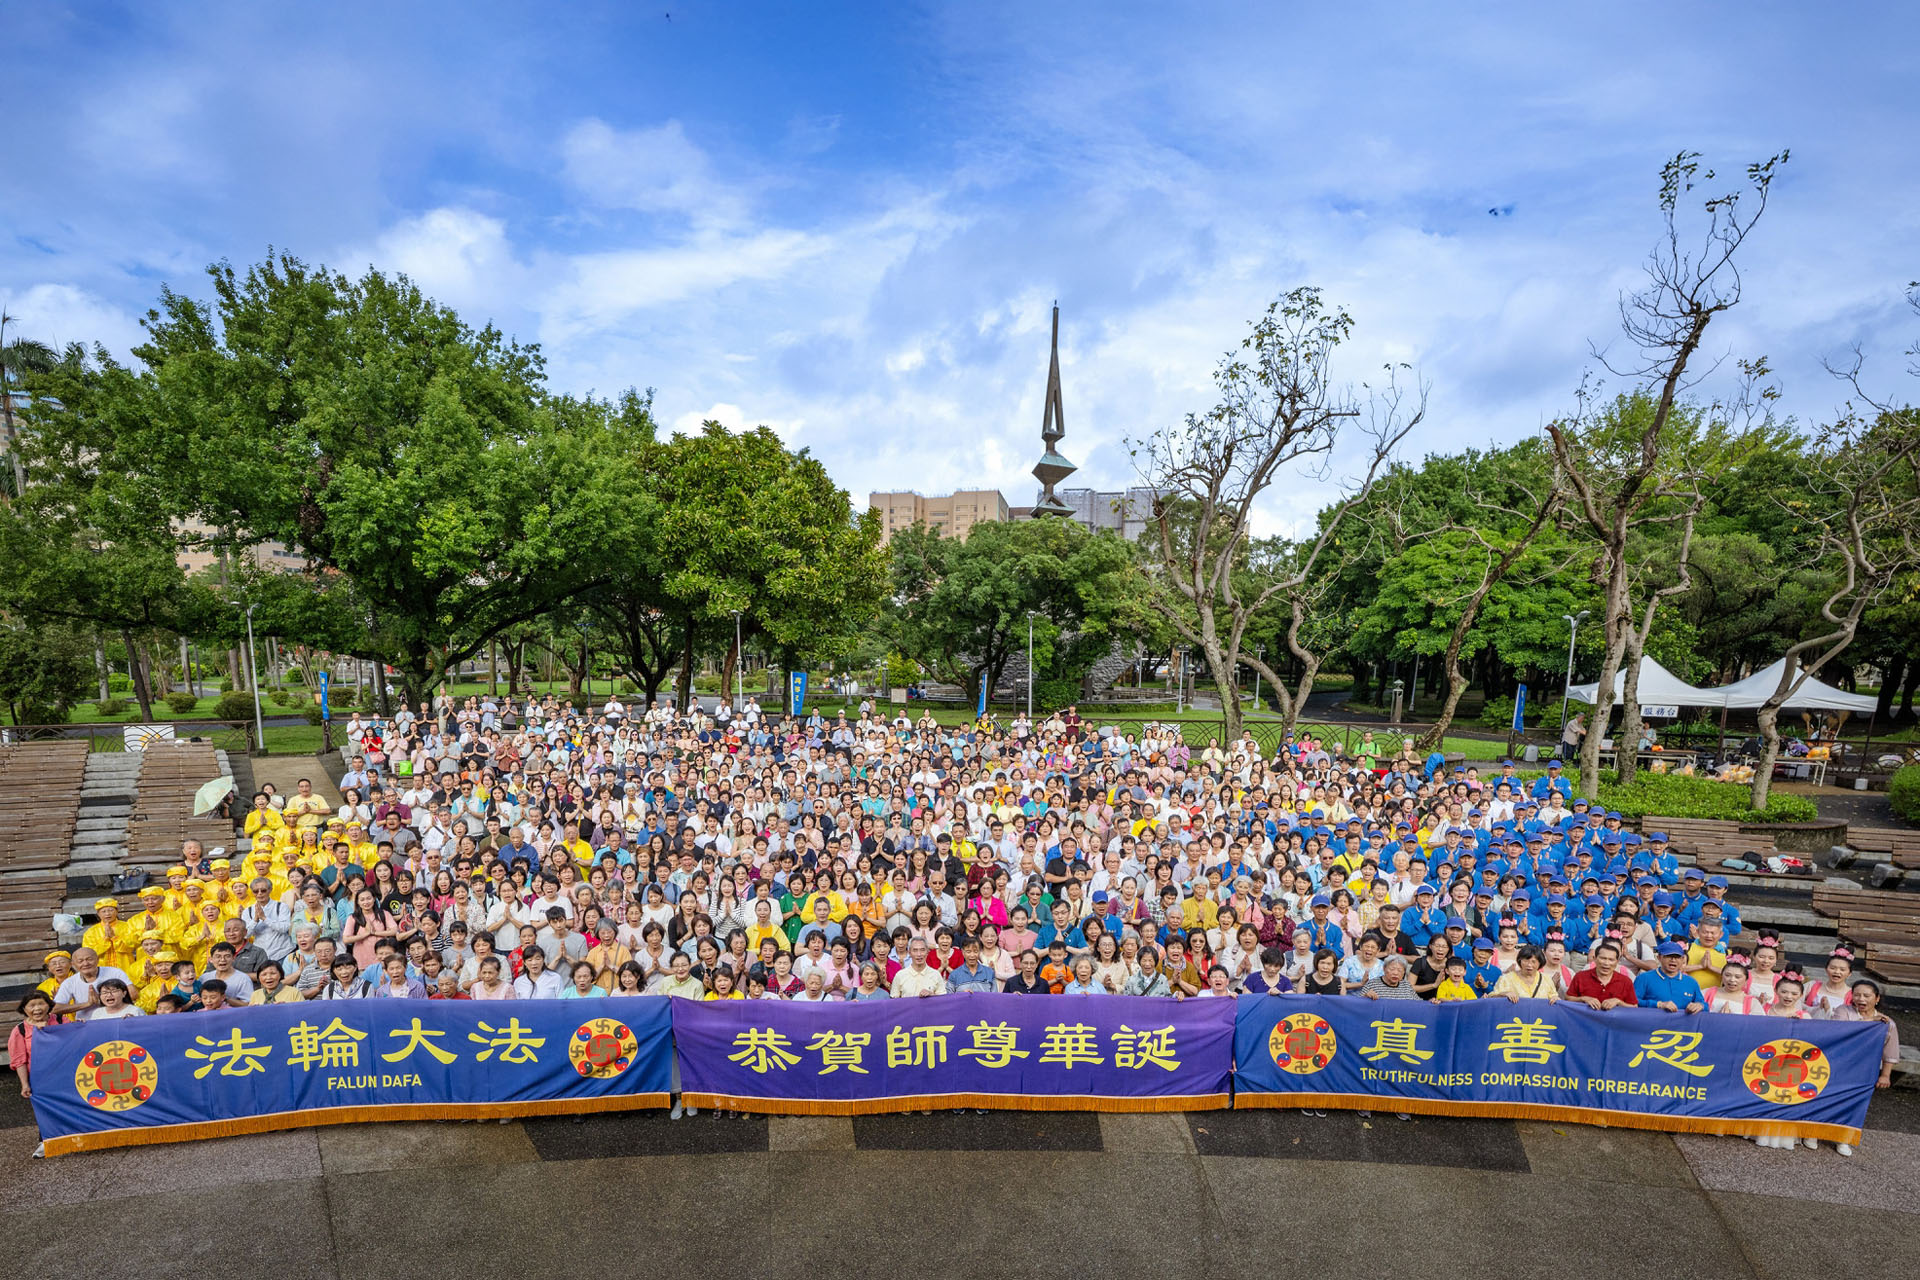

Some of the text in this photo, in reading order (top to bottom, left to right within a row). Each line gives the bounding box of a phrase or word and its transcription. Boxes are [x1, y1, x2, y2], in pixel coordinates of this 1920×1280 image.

[184, 1016, 546, 1079] 法輪大法
[727, 1020, 1182, 1075] 恭賀師尊華誕
[1358, 1017, 1715, 1078] 真善忍
[327, 1073, 423, 1091] FALUN DAFA
[1360, 1066, 1707, 1101] TRUTHFULNESS COMPASSION FORBEARANCE
